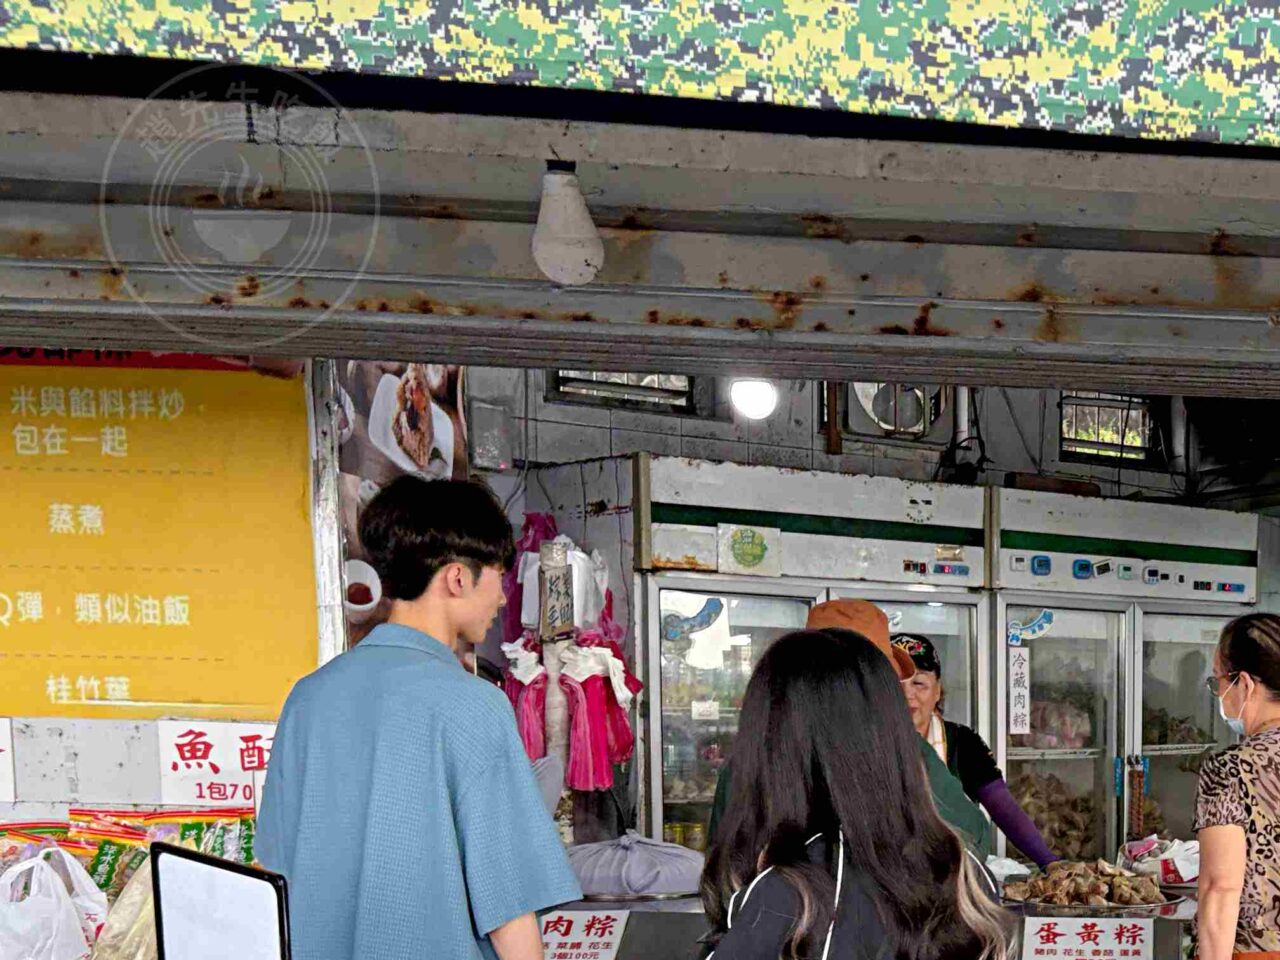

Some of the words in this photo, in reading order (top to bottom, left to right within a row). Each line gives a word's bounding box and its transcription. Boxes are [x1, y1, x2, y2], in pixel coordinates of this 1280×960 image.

[12, 423, 128, 456] 包在一起
[49, 503, 104, 534] 蒸煮
[1012, 652, 1028, 728] 冷藏肉粽
[543, 915, 617, 938] 肉粽
[1034, 922, 1145, 946] 蛋黃粽
[588, 942, 613, 950] 花生
[1063, 948, 1086, 956] 花生
